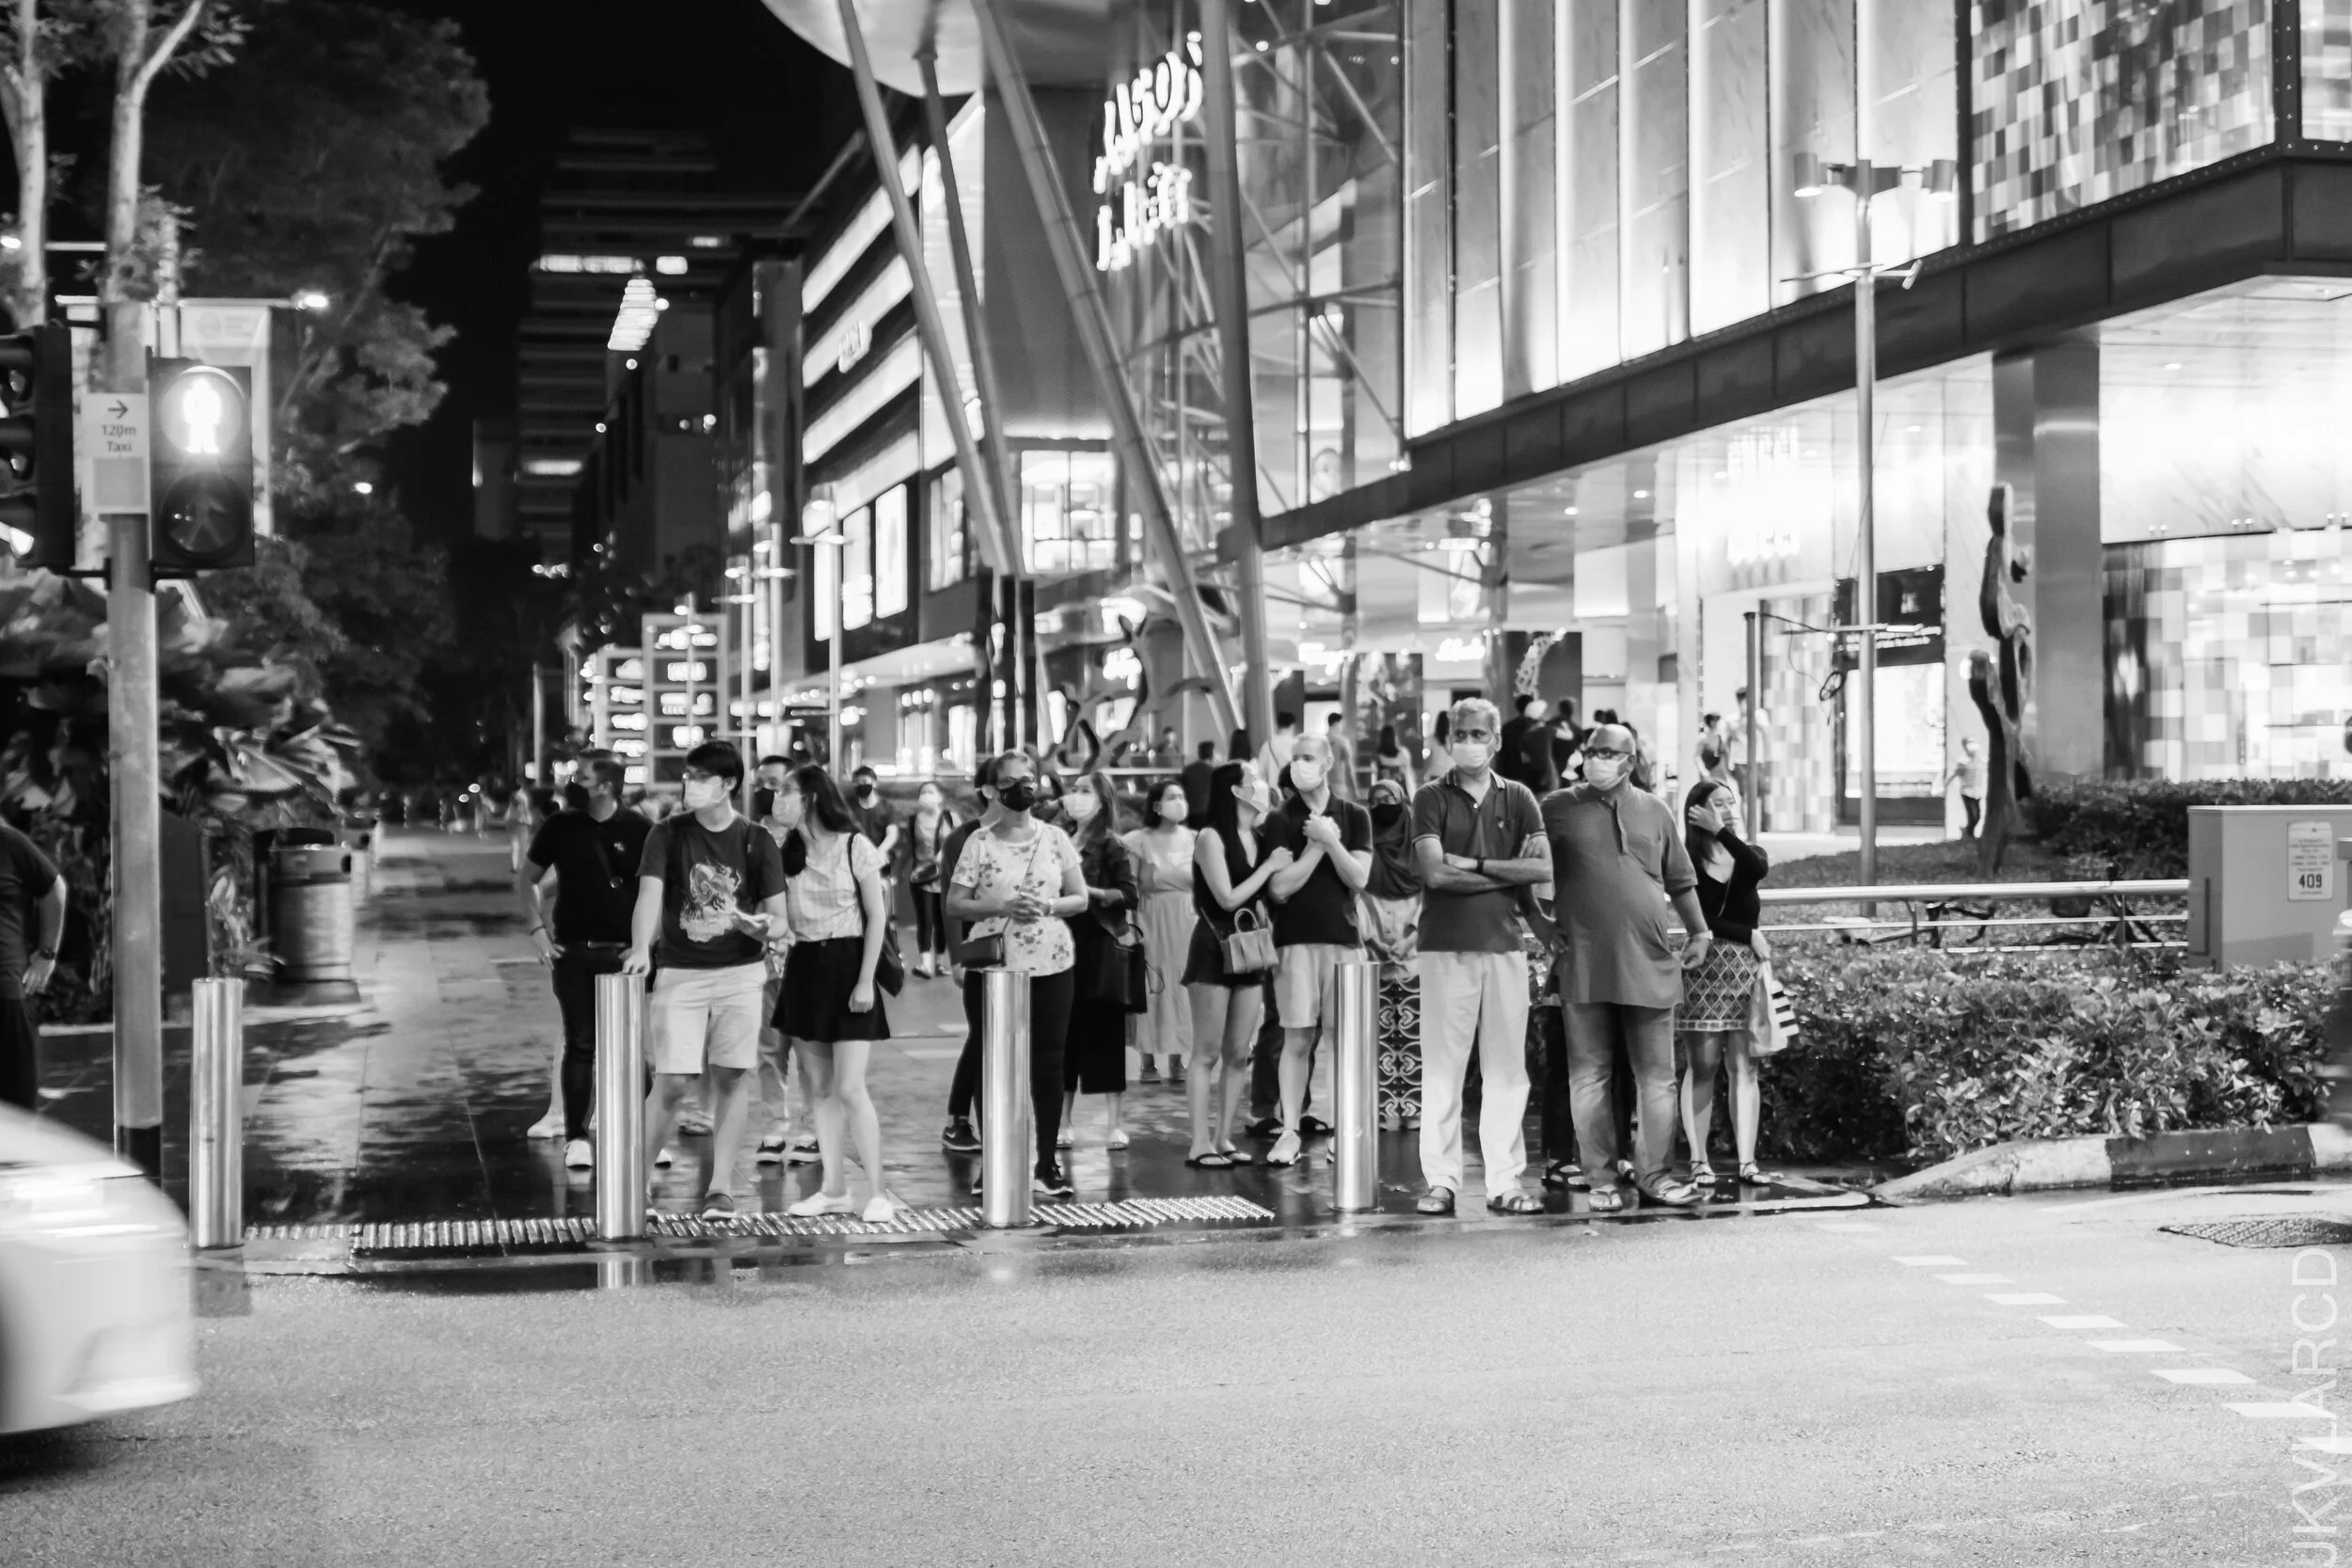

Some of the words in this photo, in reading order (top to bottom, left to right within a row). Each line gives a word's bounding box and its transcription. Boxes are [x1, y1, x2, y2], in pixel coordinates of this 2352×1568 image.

[102, 424, 136, 437] 120m
[106, 440, 132, 452] Taxi
[2298, 873, 2322, 889] 409
